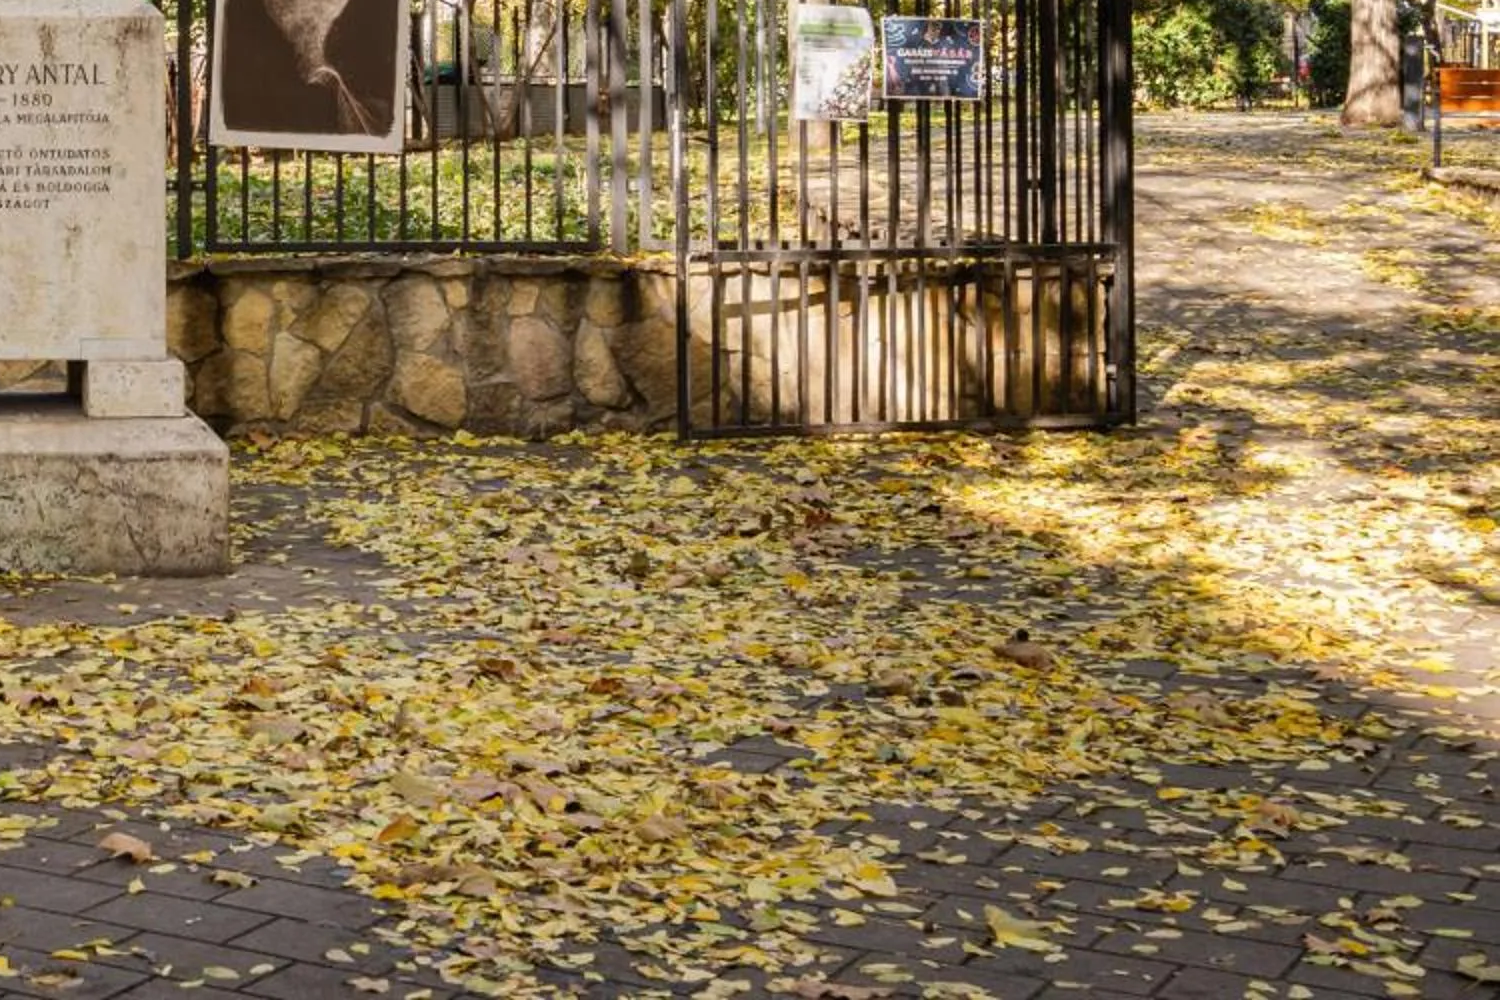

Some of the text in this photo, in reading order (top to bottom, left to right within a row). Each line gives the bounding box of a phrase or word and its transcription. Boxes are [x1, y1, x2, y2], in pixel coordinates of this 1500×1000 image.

[26, 63, 107, 86] ANTAL
[13, 92, 53, 107] 1880
[25, 162, 113, 177] TÁRSADALOM
